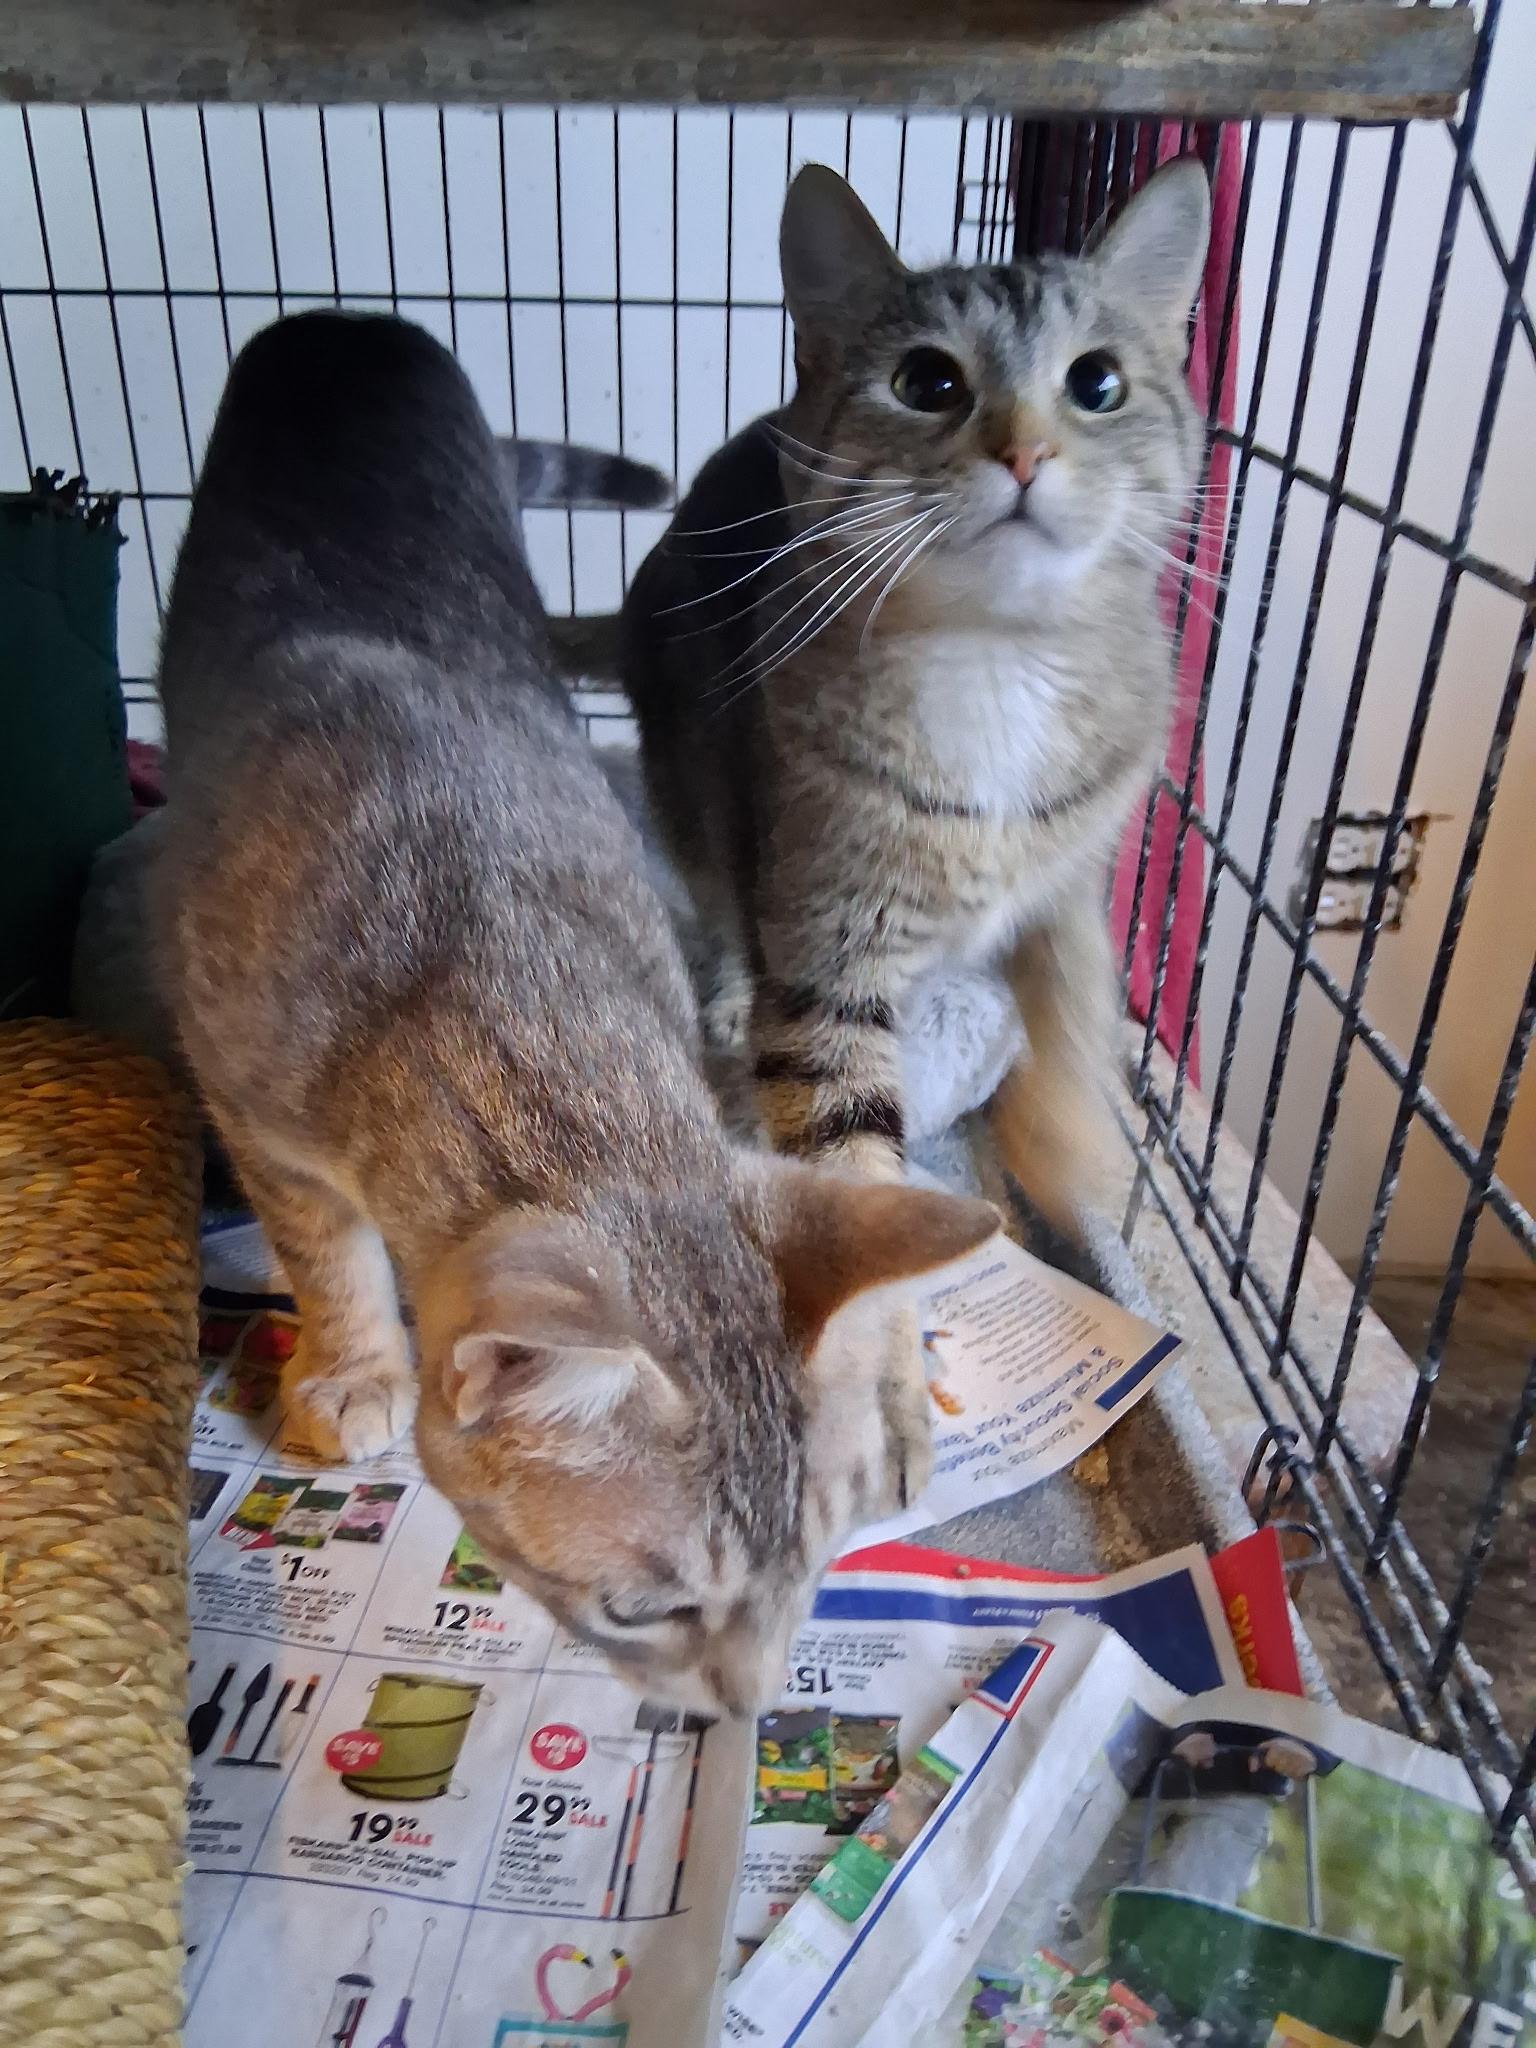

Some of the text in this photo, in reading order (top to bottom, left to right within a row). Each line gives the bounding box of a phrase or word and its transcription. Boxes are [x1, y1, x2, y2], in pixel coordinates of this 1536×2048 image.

[1015, 1358, 1093, 1414] Minimize
[1071, 1355, 1125, 1400] Social
[975, 1411, 1018, 1436] Your
[1000, 1399, 1073, 1445] Security
[392, 1830, 434, 1847] SALE
